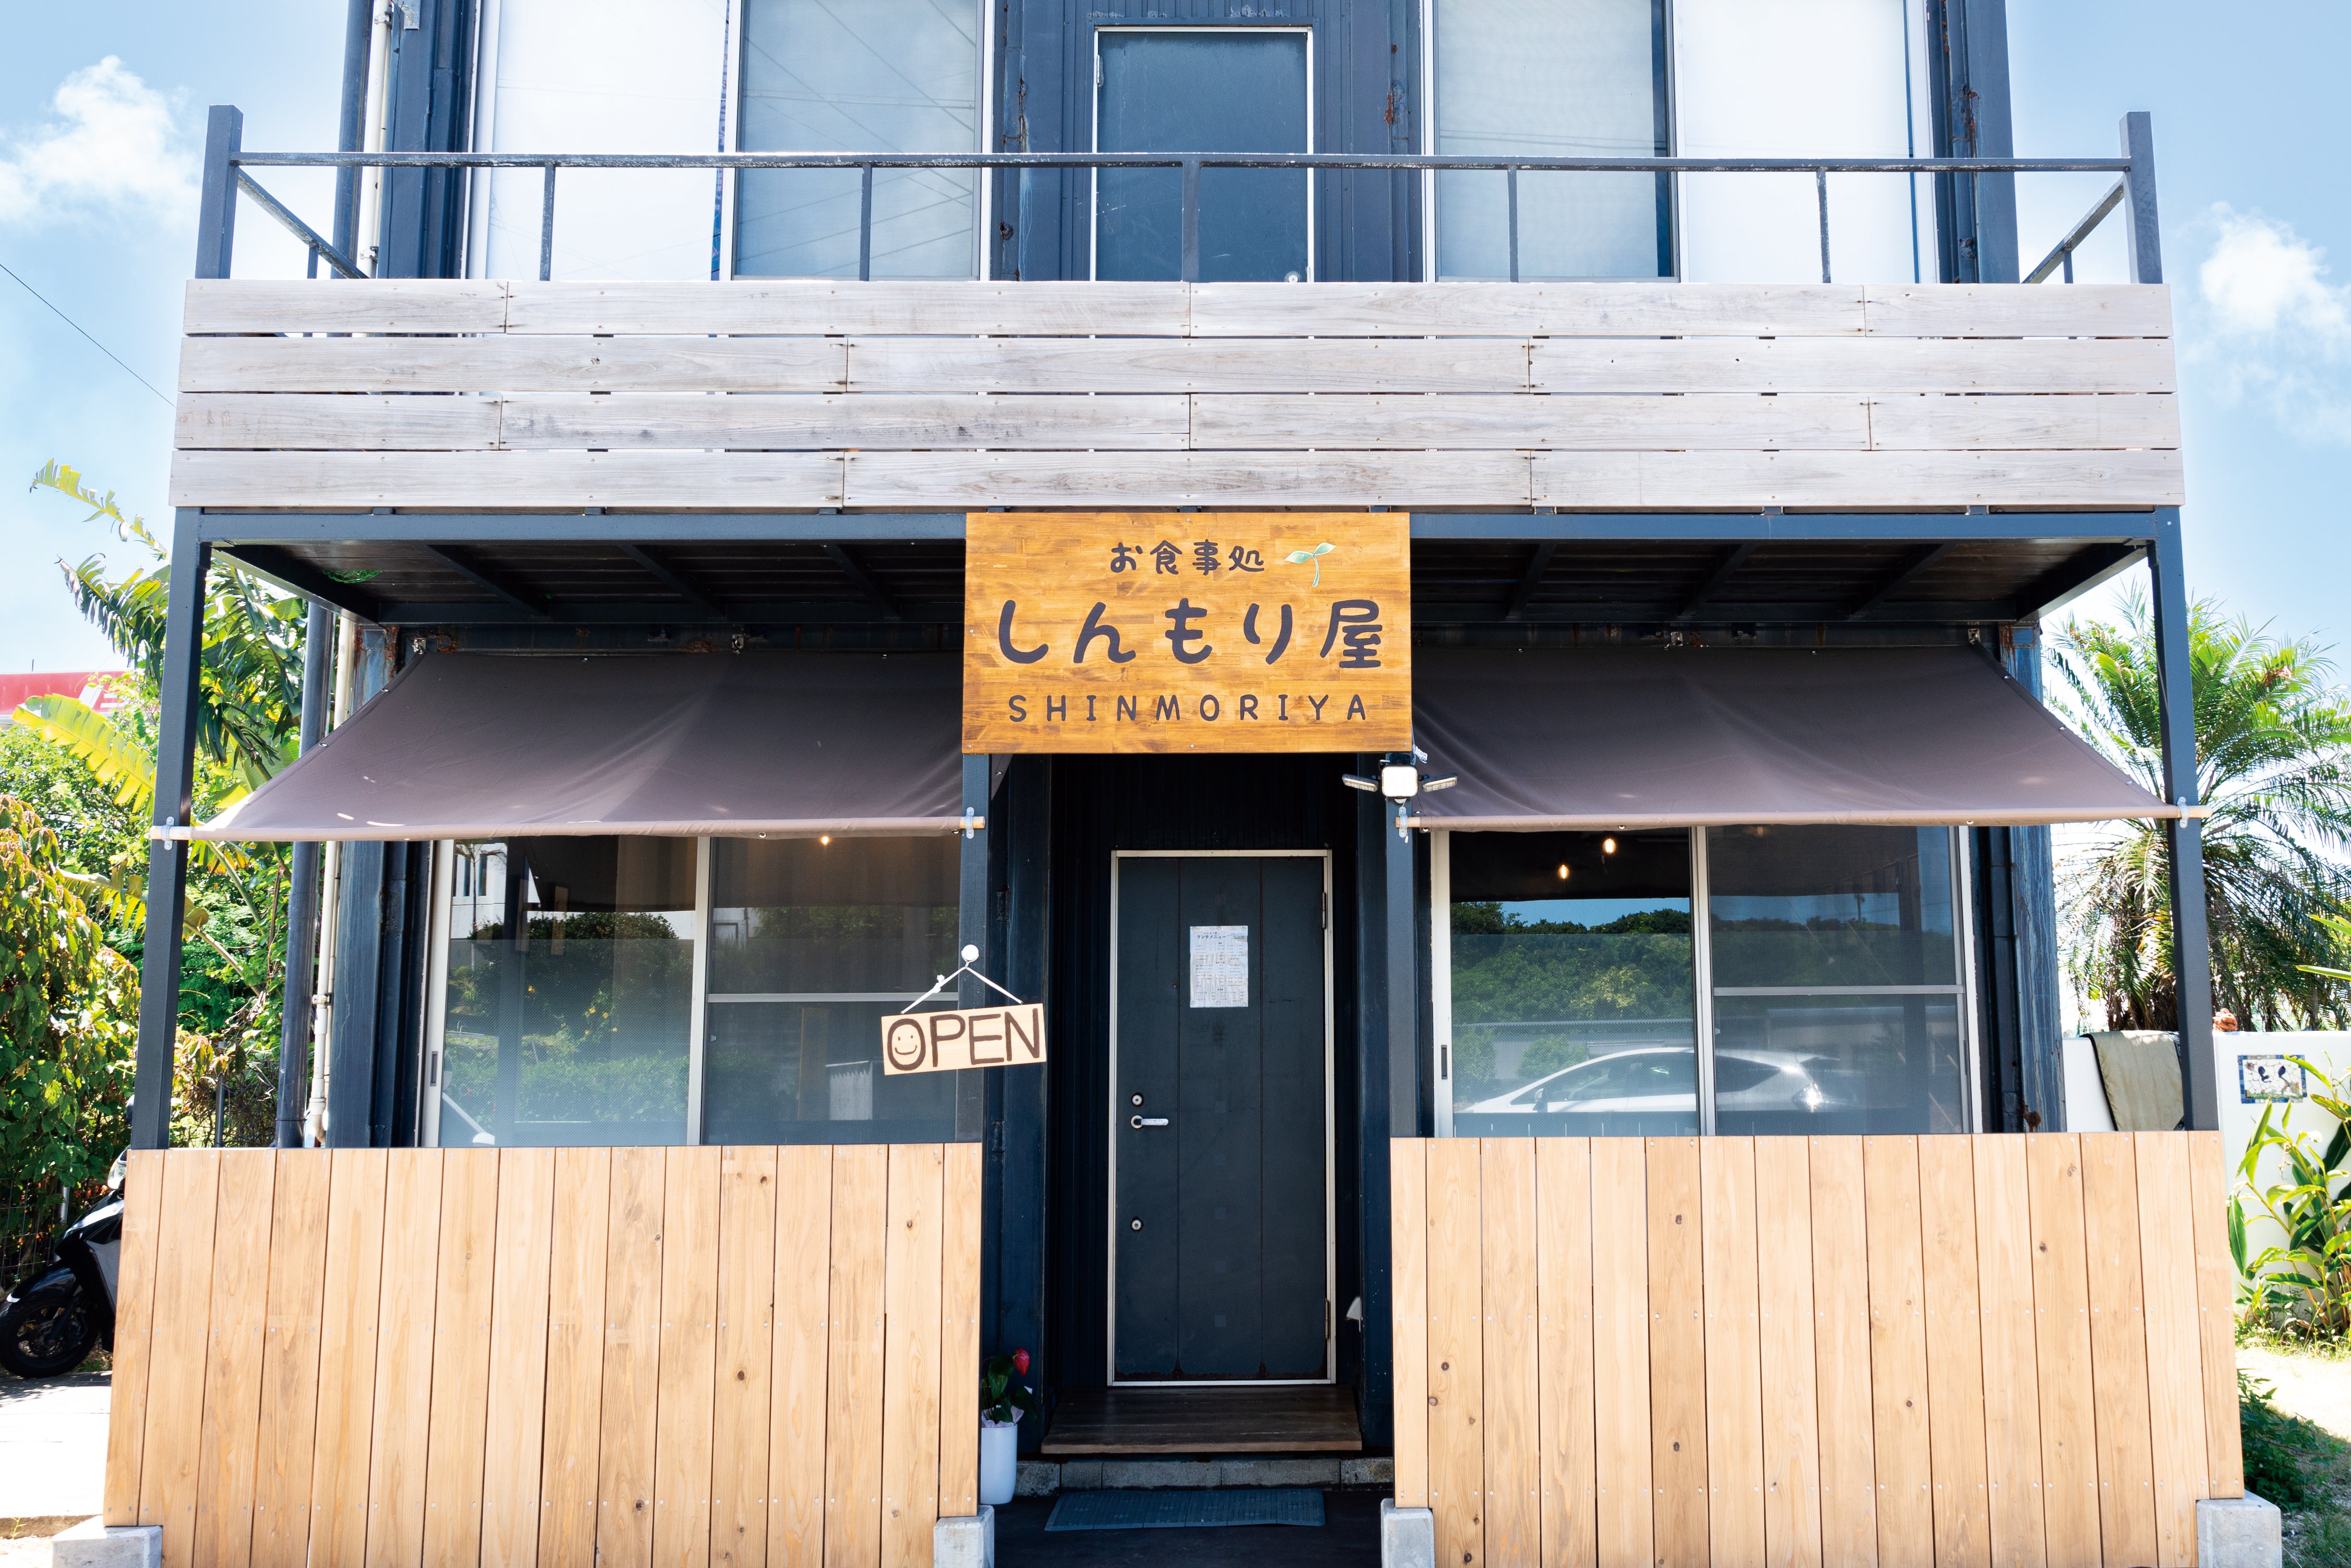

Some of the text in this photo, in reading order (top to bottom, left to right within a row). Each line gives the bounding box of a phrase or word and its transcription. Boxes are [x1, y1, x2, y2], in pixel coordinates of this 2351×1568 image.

[1110, 539, 1265, 576] お食事処
[999, 598, 1383, 668] しんもり屋
[1009, 694, 1366, 722] SHINMORIYA
[887, 1008, 1040, 1071] OPEN
